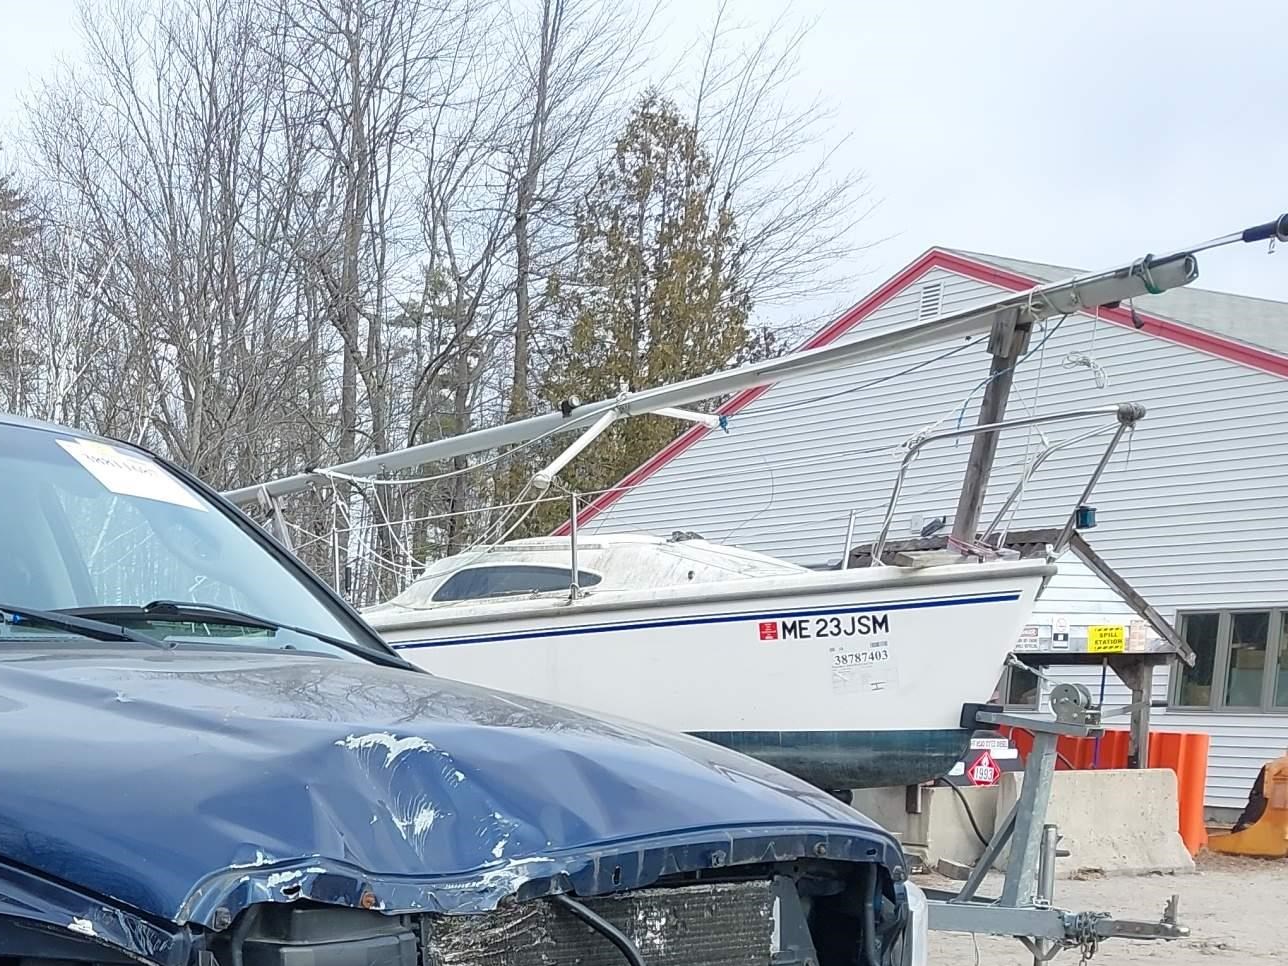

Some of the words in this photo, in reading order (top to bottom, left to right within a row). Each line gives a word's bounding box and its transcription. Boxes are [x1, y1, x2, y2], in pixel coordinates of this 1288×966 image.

[781, 619, 811, 640] ME
[815, 613, 890, 638] 23JSM
[834, 649, 889, 666] 38787403
[975, 766, 993, 780] 1993
